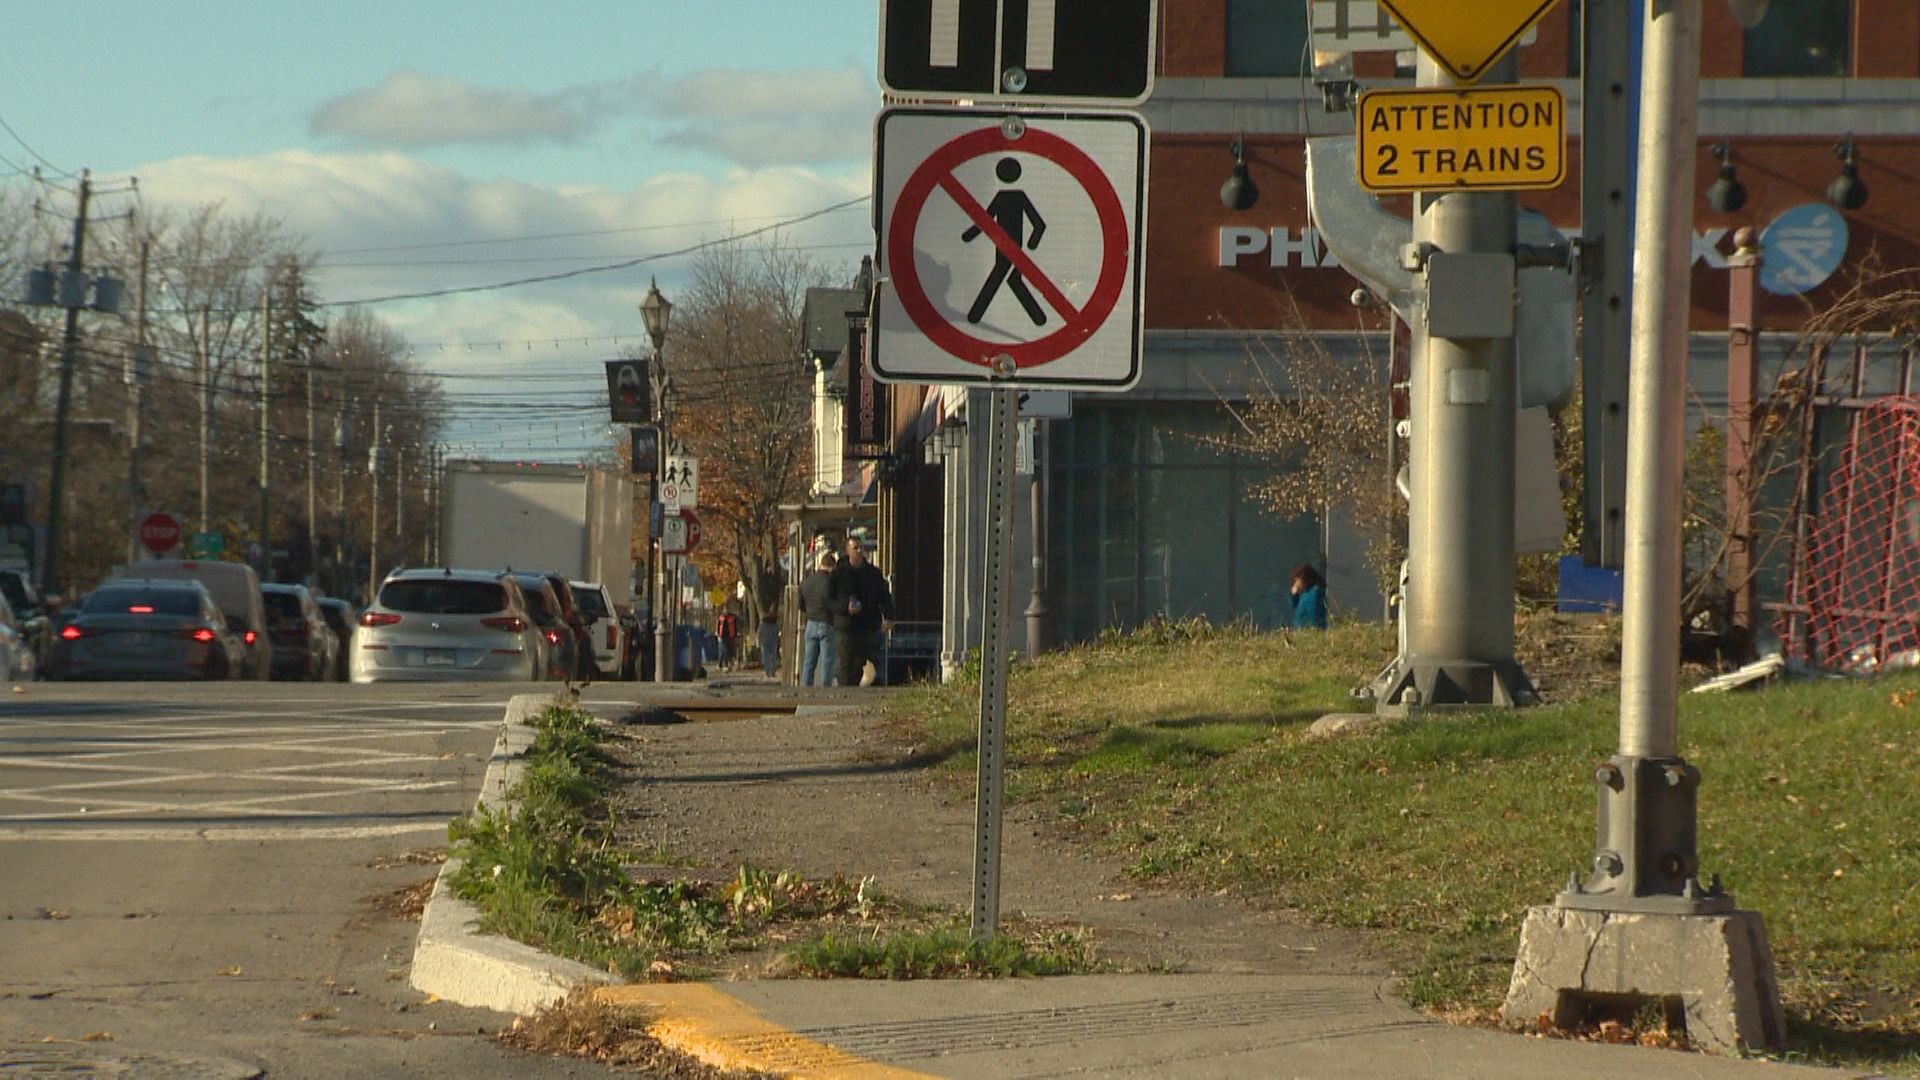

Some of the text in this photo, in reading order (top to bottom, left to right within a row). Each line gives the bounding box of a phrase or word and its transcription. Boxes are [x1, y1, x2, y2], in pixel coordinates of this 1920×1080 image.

[1371, 101, 1553, 132] ATTENTION
[1377, 145, 1545, 175] 2 TRAINS
